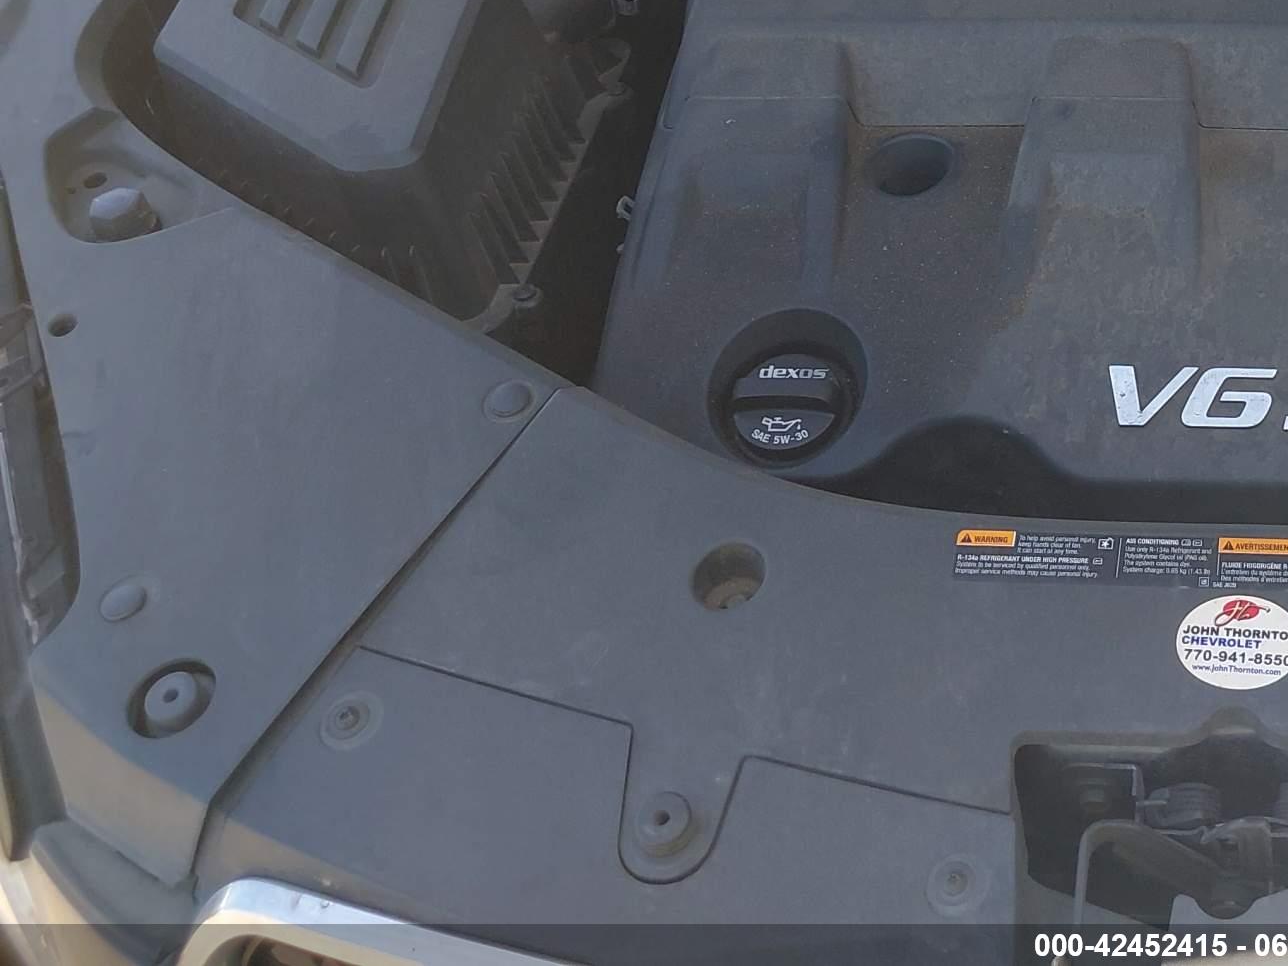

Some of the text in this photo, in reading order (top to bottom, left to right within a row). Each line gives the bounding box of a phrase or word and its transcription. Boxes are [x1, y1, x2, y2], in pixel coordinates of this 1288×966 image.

[759, 365, 829, 379] dexos
[1108, 365, 1278, 427] V6
[751, 429, 809, 445] SAE 5W-30
[974, 535, 1008, 544] WARNING
[1182, 625, 1220, 636] JOHN
[1182, 635, 1262, 649] CHEVROLET
[1192, 664, 1282, 676] www.JohnThornton.com
